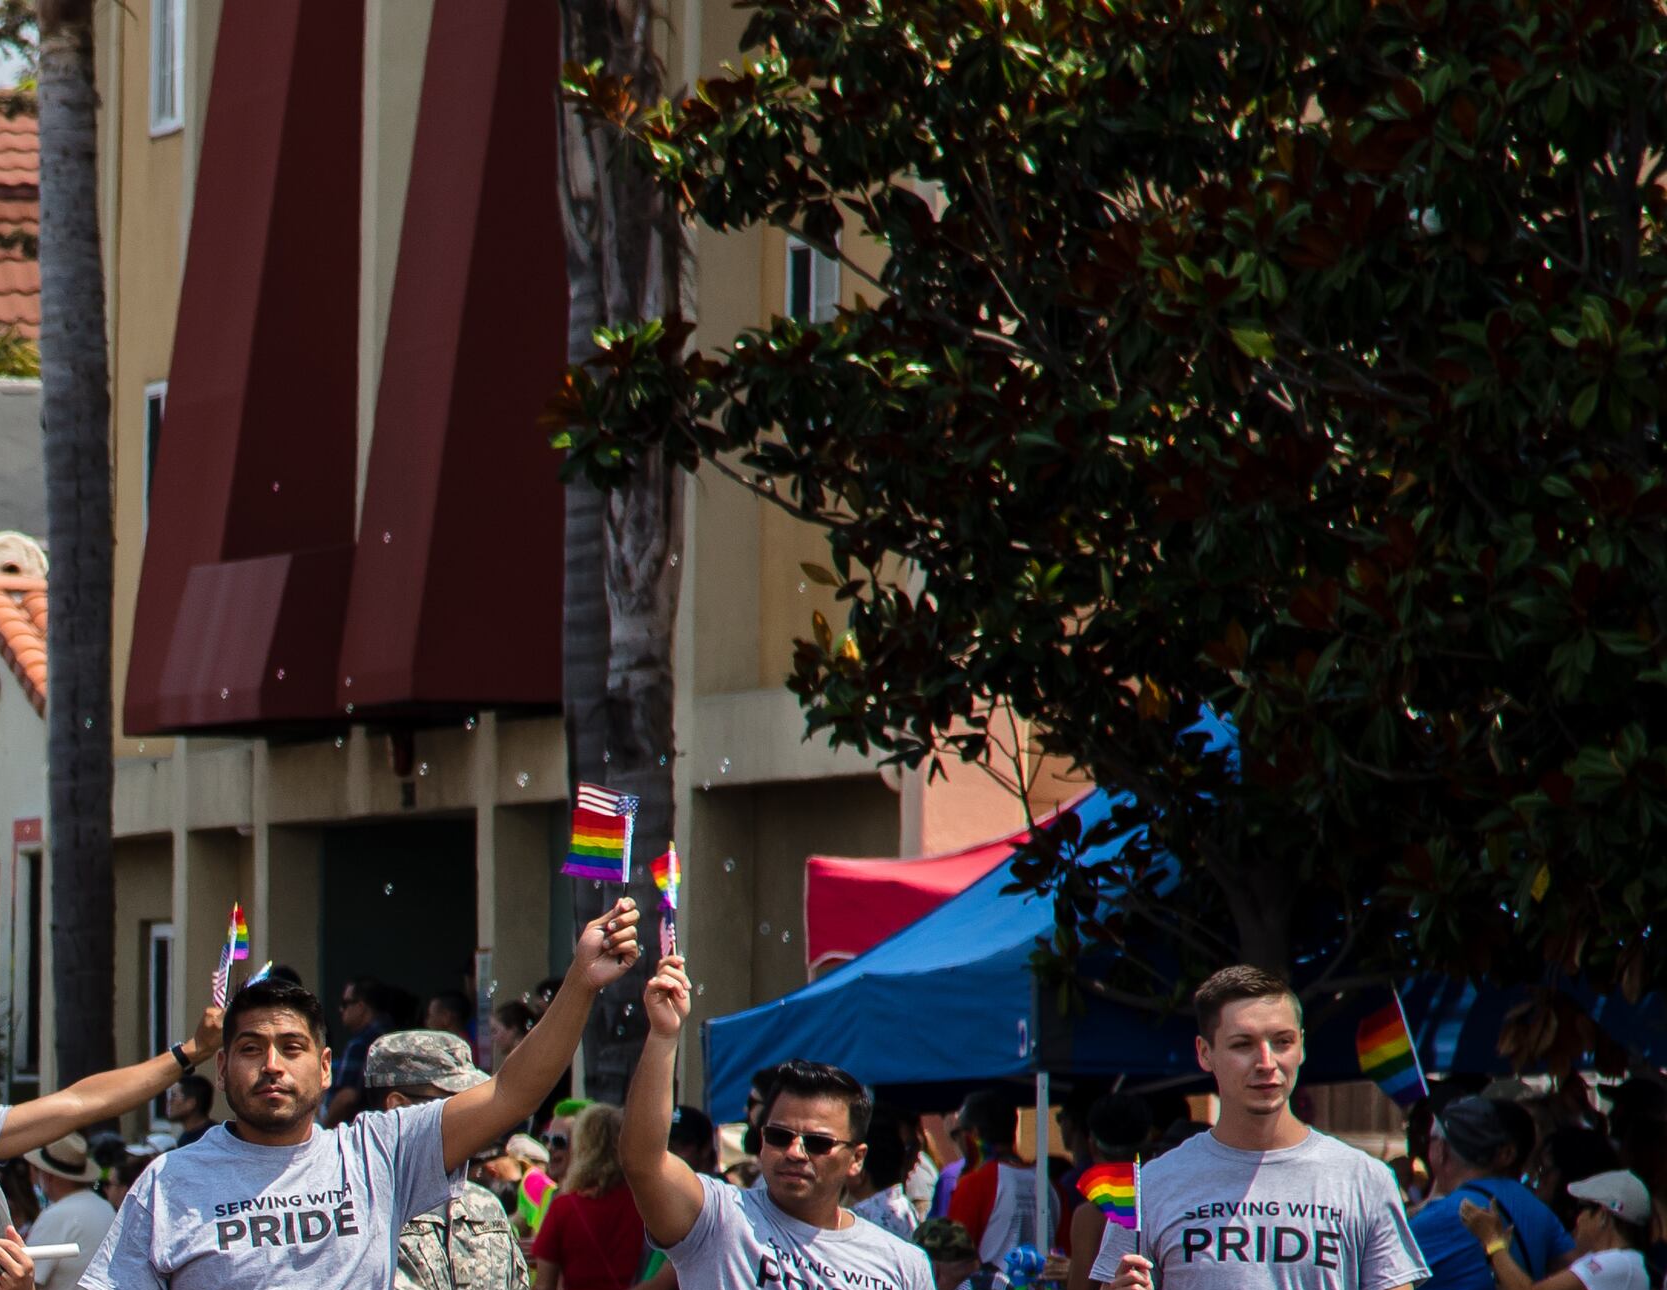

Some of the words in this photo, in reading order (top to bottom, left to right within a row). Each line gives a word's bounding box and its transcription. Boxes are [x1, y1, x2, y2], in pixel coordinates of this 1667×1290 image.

[215, 1195, 302, 1217] SERVING
[307, 1182, 353, 1206] WITH
[1184, 1201, 1280, 1221] SERVING
[1287, 1202, 1343, 1222] WITH
[216, 1200, 360, 1251] PRIDE
[1182, 1225, 1341, 1271] PRIDE
